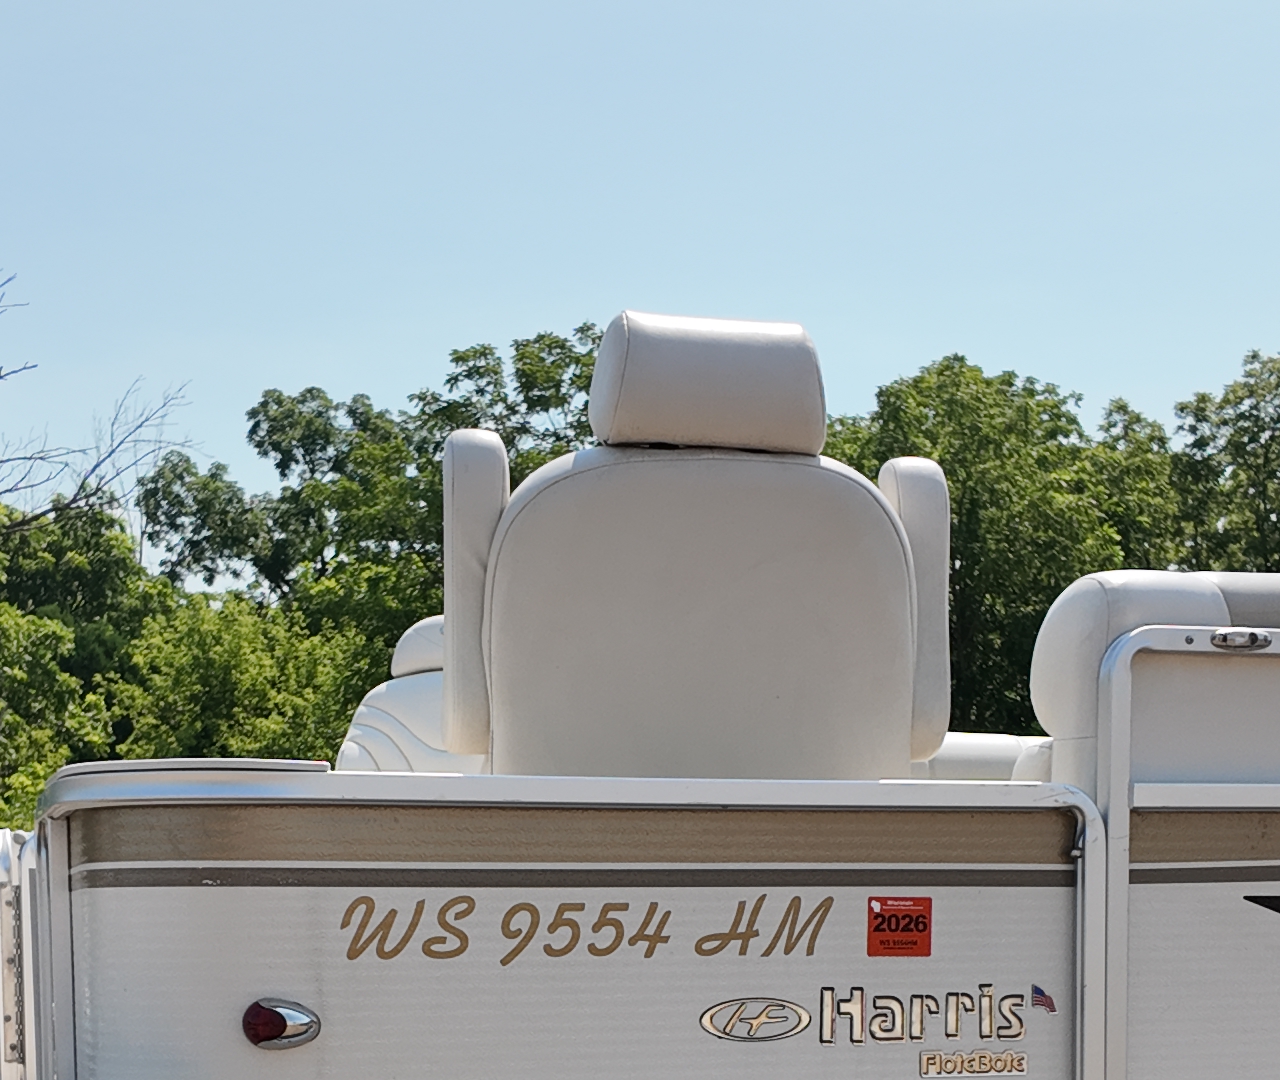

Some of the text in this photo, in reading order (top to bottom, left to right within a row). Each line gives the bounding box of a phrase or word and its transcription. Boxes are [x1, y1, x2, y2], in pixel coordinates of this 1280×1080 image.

[340, 893, 835, 967] WS 9554 HM
[873, 913, 928, 933] 2026
[819, 983, 1027, 1046] Harris
[922, 1053, 1025, 1075] FloteBote
